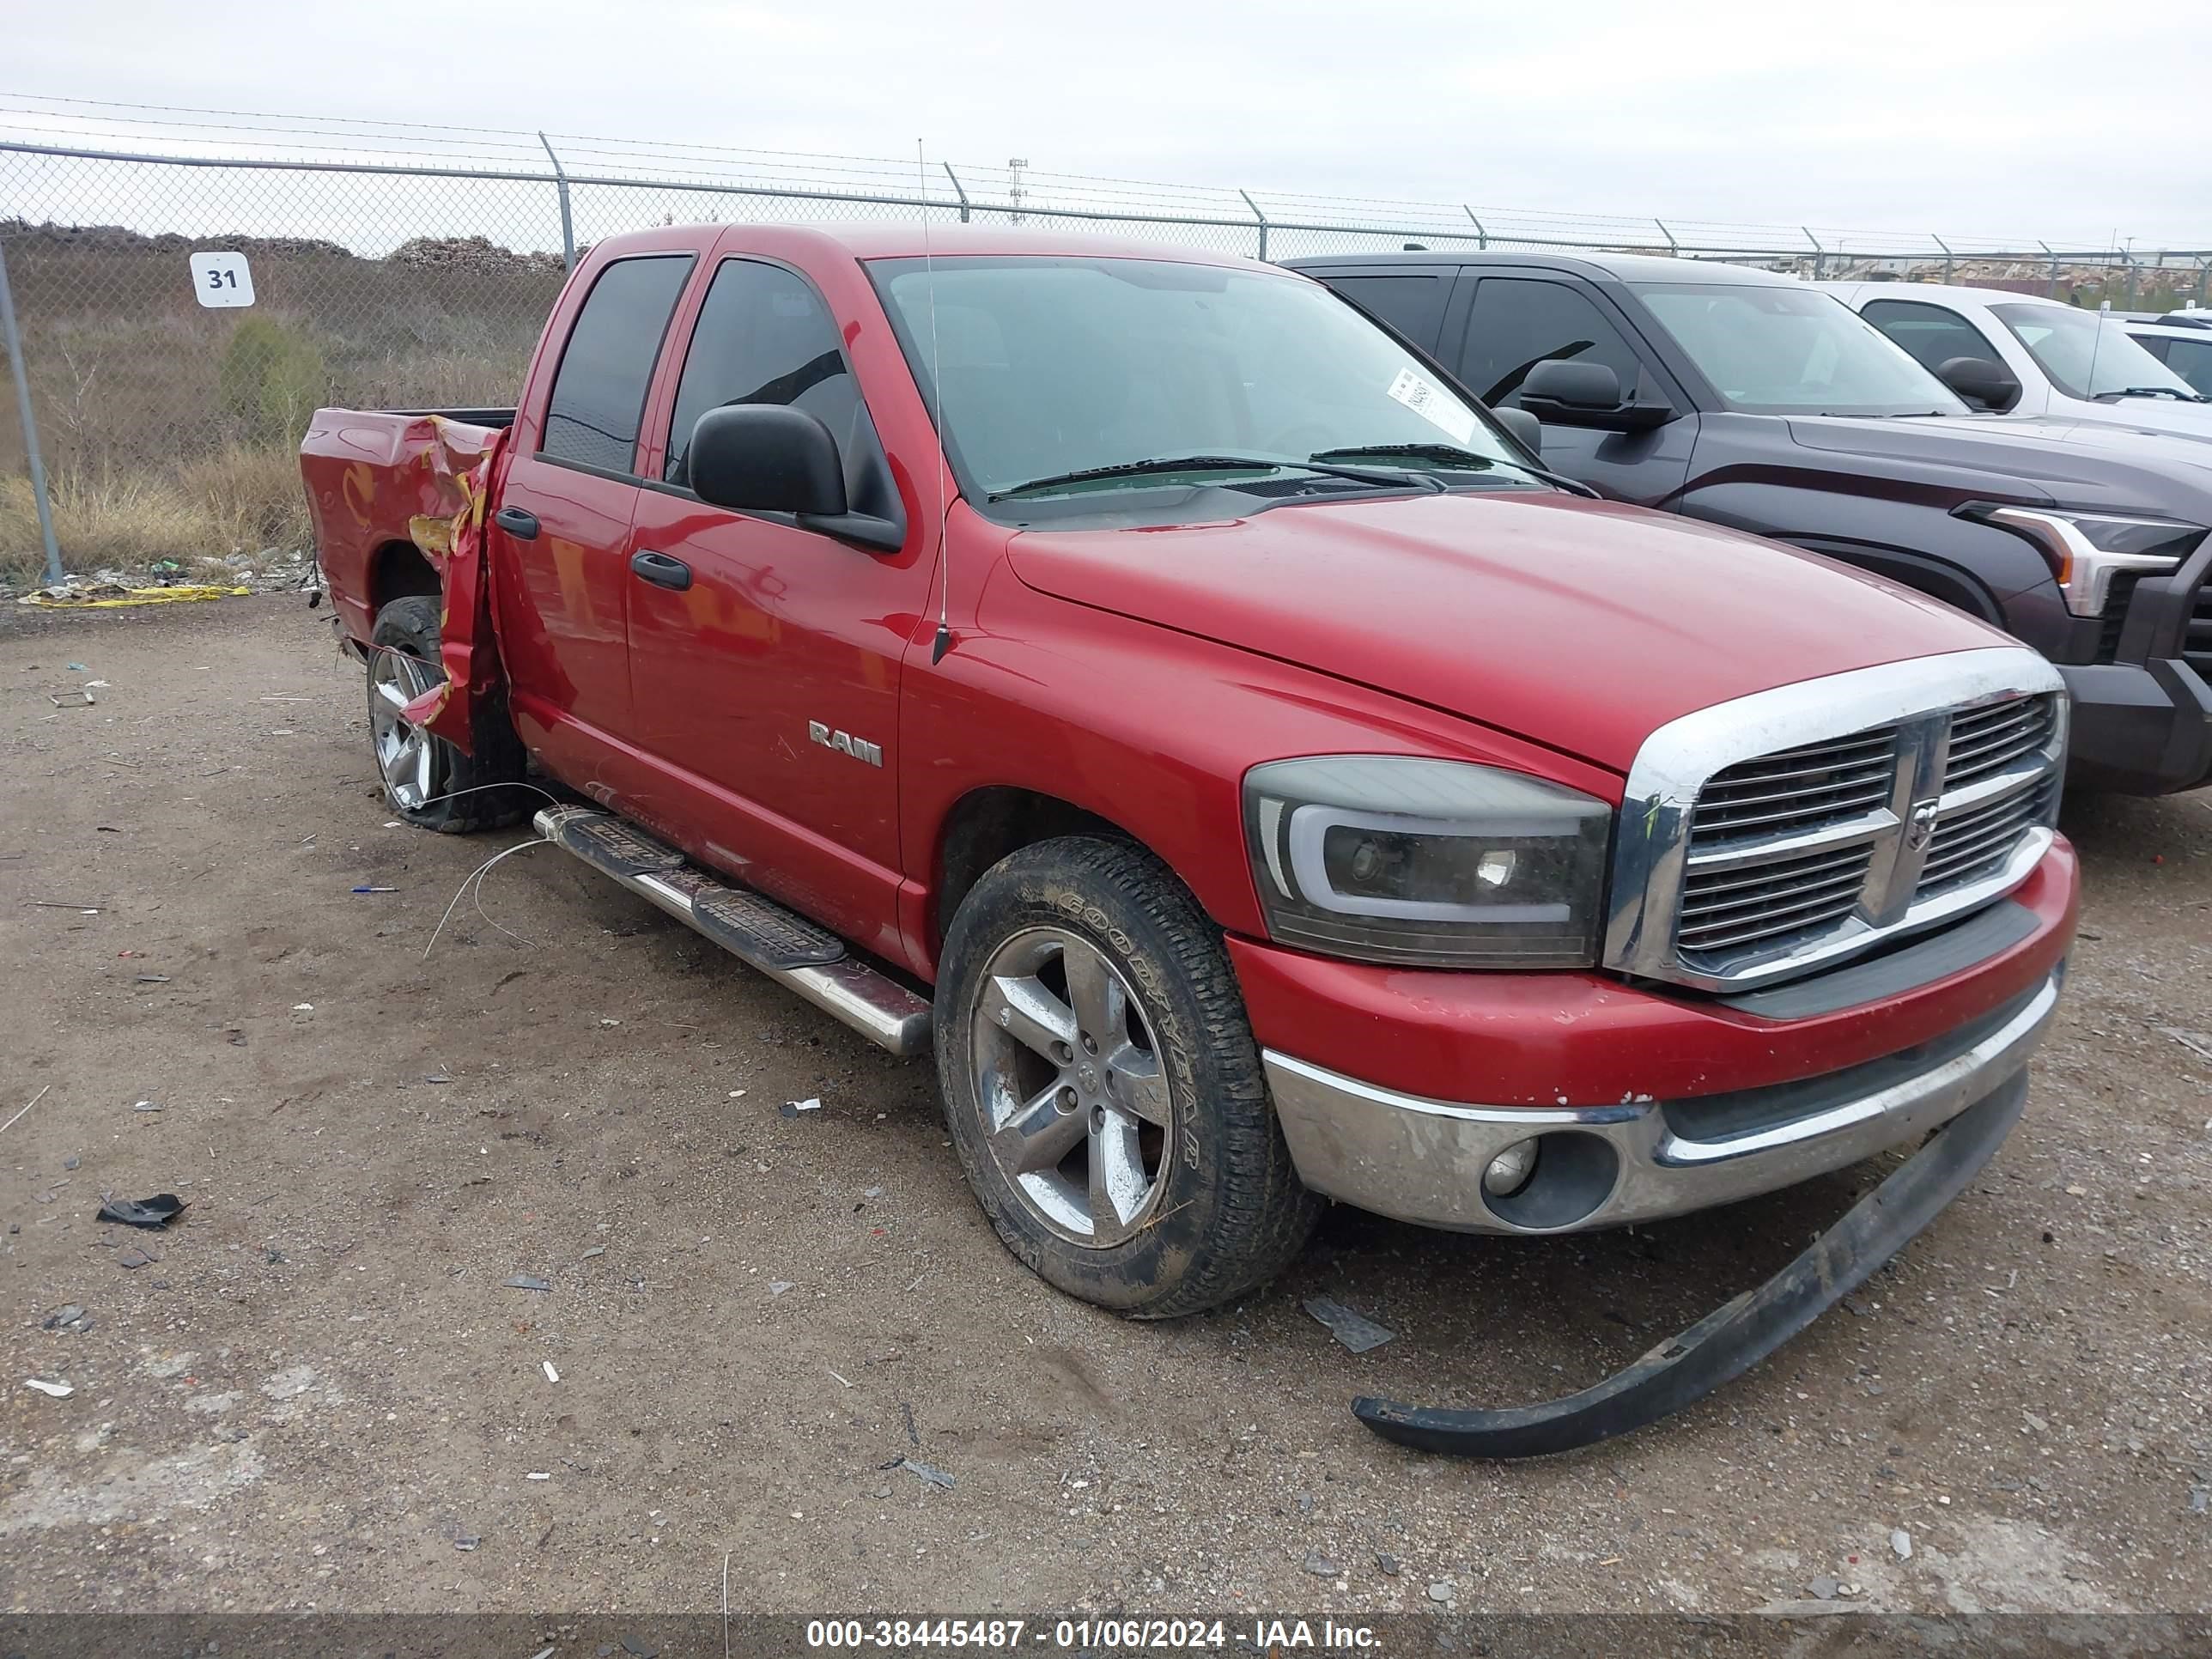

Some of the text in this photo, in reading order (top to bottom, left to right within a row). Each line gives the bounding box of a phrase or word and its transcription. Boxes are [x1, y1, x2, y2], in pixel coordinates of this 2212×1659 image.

[207, 270, 237, 289] 31
[809, 720, 882, 768] RAM
[1059, 892, 1200, 1170] GOODYEAR
